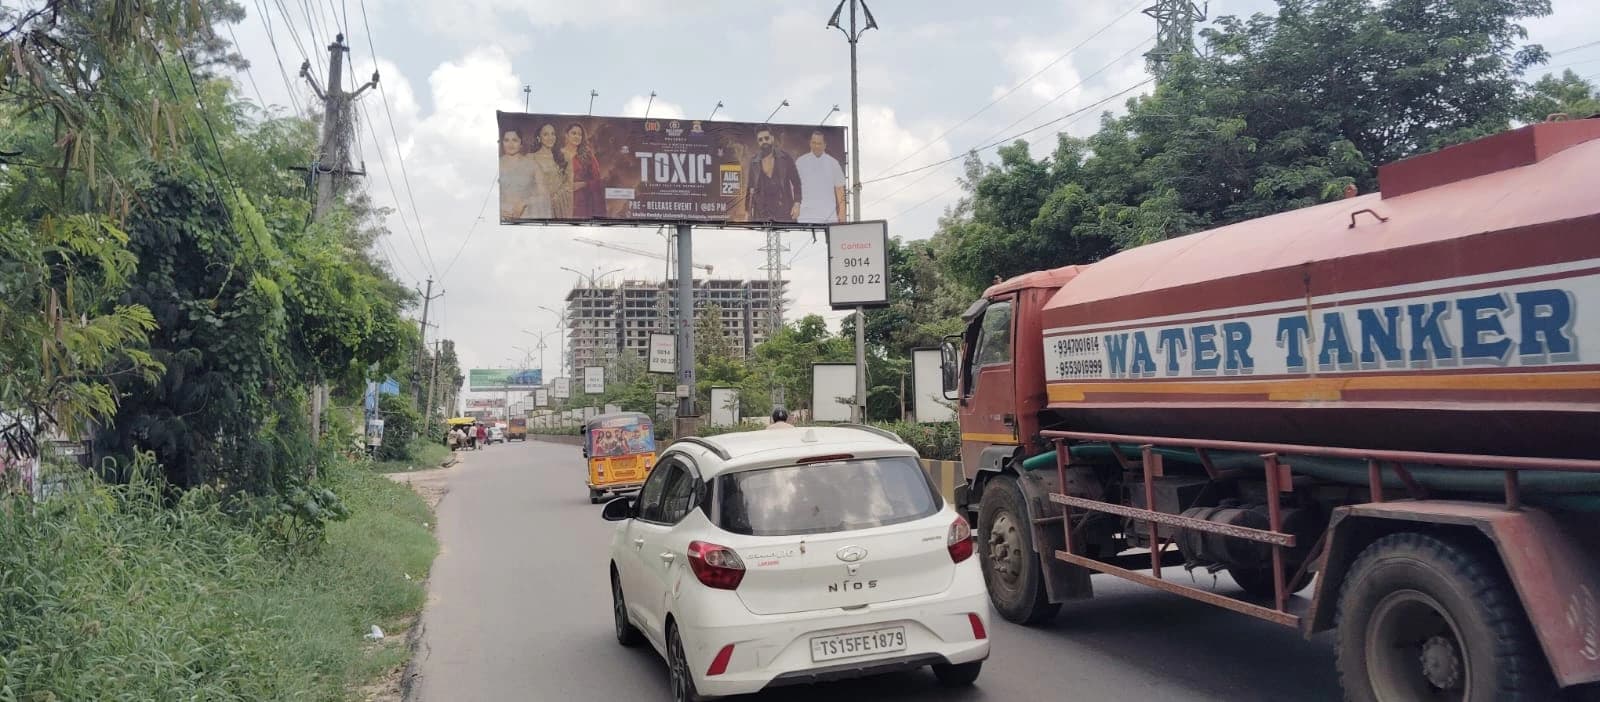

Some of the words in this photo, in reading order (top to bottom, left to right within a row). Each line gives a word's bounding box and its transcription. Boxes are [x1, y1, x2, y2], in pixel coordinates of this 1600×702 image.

[635, 152, 712, 184] TOXIC
[723, 171, 739, 181] AUG
[629, 201, 641, 210] PRE
[647, 201, 673, 210] RELEASE
[674, 202, 692, 211] EVENT
[841, 242, 871, 250] Contact
[843, 257, 870, 267] 9014
[835, 276, 848, 285] 22
[851, 275, 864, 285] 00
[867, 274, 881, 283] 22
[1104, 320, 1254, 377] WATER
[1276, 289, 1577, 371] TANKER
[828, 580, 878, 593] NIOS
[820, 632, 904, 655] TS15FE1879
